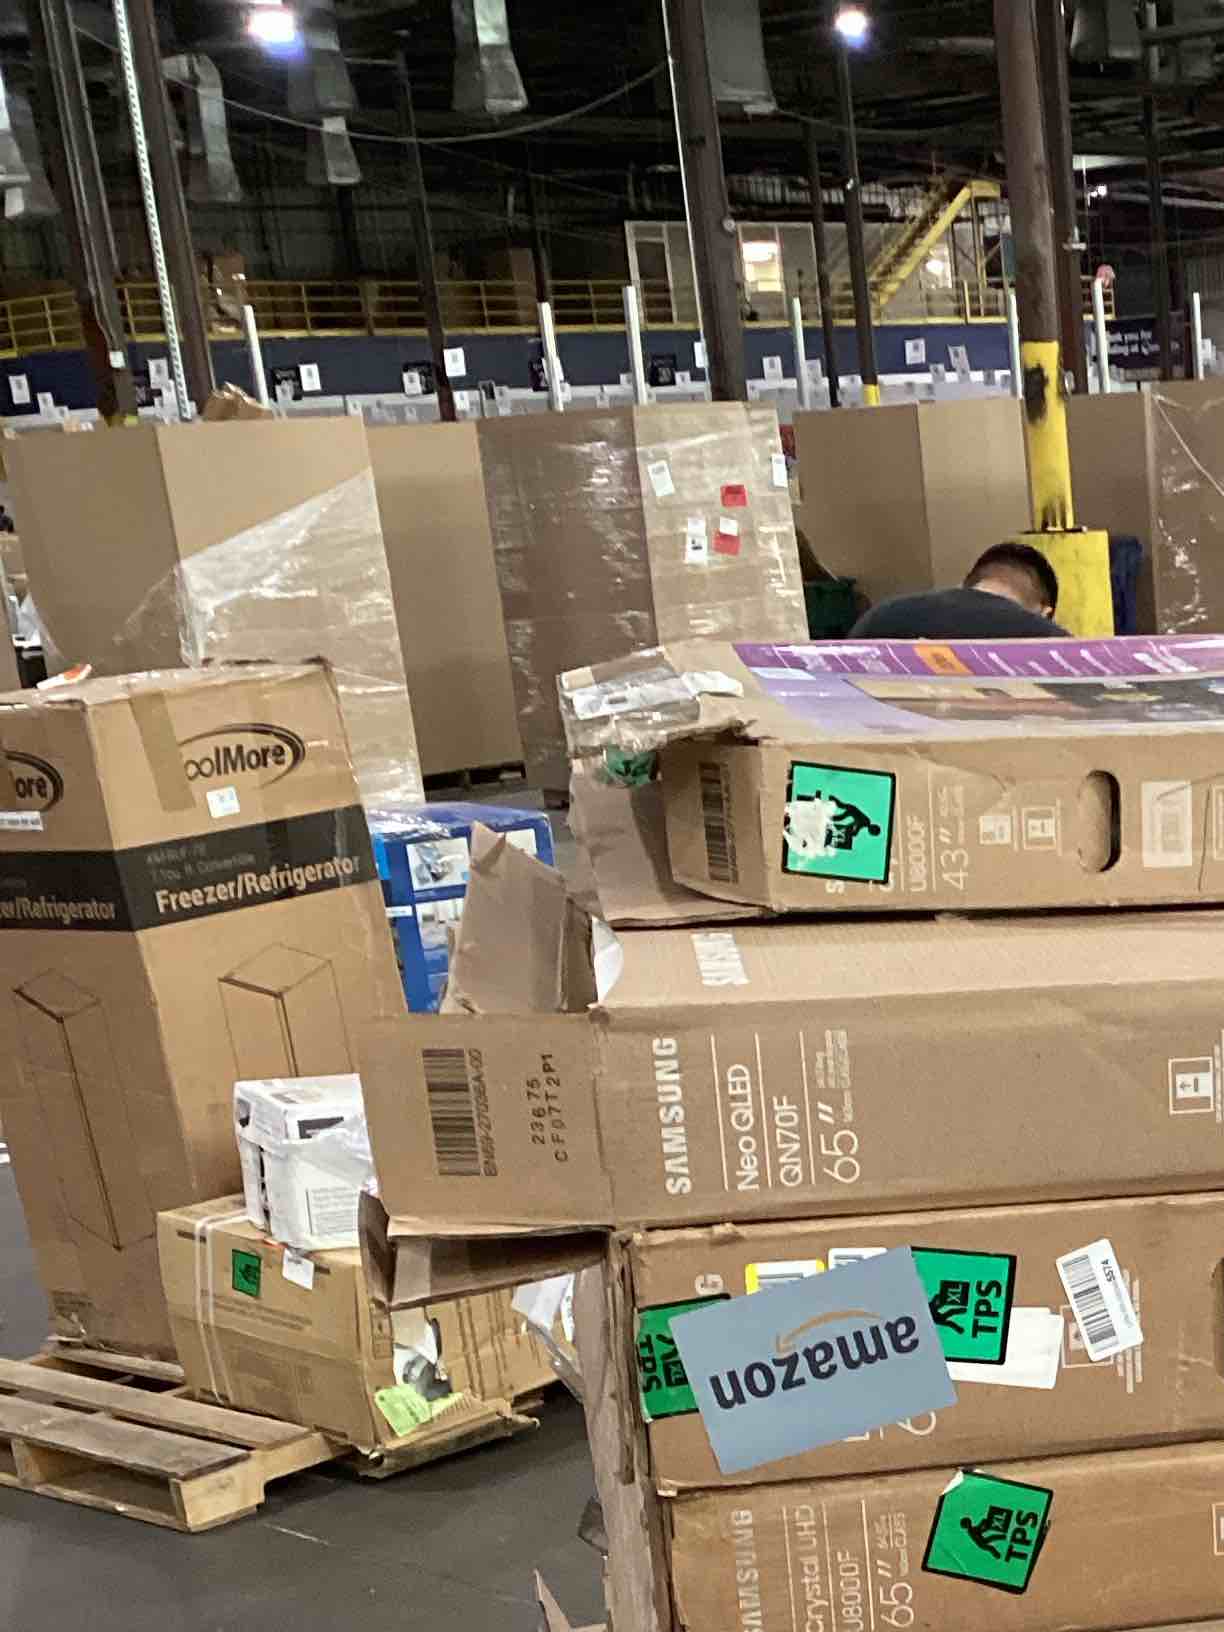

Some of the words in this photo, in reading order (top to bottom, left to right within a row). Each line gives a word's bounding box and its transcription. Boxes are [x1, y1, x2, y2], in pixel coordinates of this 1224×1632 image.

[185, 746, 287, 782] oolMore
[154, 855, 361, 915] Freezer/Refrigerator
[652, 1036, 692, 1196] SAMSUNG
[726, 1063, 755, 1132] QLED
[736, 1134, 760, 1192] Neo
[773, 1095, 803, 1188] QN70F
[971, 1279, 1003, 1339] TPS
[638, 1334, 662, 1394] TPS
[708, 1315, 920, 1410] amazon
[795, 1503, 817, 1552] UHD
[1004, 1508, 1042, 1564] TPS
